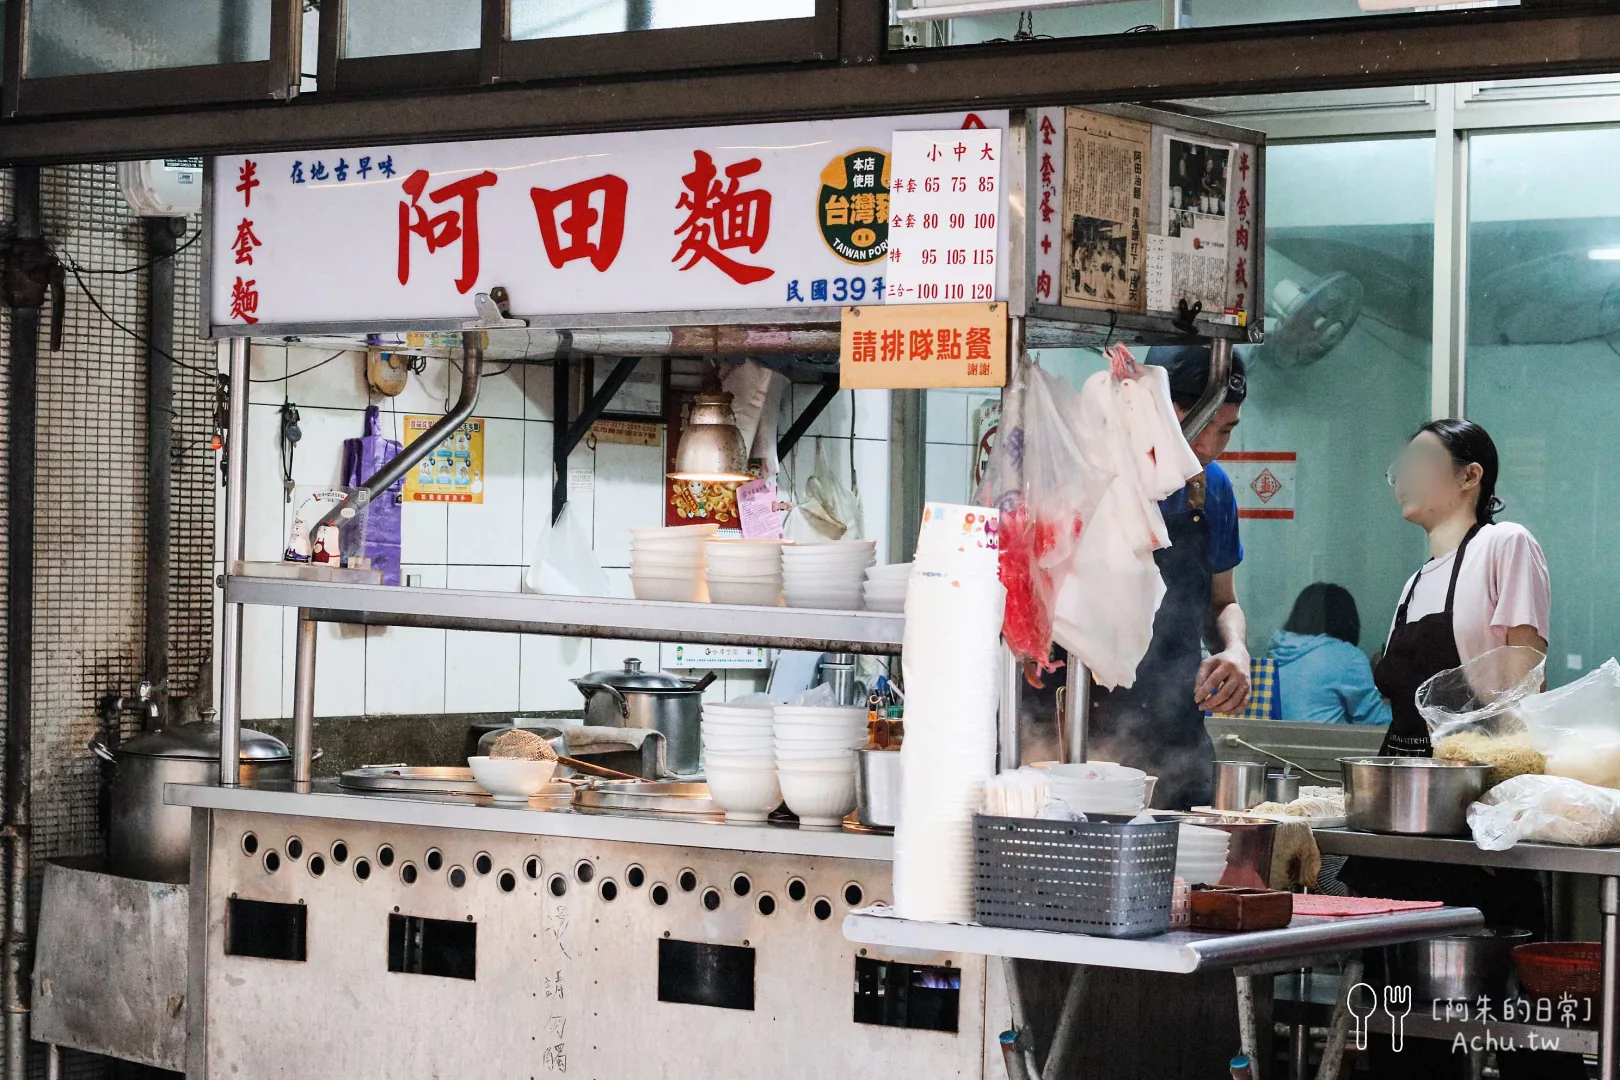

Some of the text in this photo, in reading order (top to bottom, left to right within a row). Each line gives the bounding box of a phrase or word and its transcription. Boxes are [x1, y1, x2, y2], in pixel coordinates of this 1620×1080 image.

[927, 142, 995, 162] 小 中 大
[289, 154, 396, 185] 在地古早味
[853, 157, 875, 171] 本店
[853, 174, 875, 188] 使用
[893, 176, 994, 193] 半套 65 75 85
[397, 149, 776, 295] 阿田麵
[892, 213, 995, 229] 全套 80 90 100
[230, 159, 262, 325] 半套麵
[832, 237, 867, 260] TAIWAN
[889, 248, 994, 265] 特 95 105 115
[917, 284, 938, 300] 100
[944, 284, 964, 300] 110
[971, 284, 993, 300] 120
[852, 327, 992, 363] 請排隊點餐
